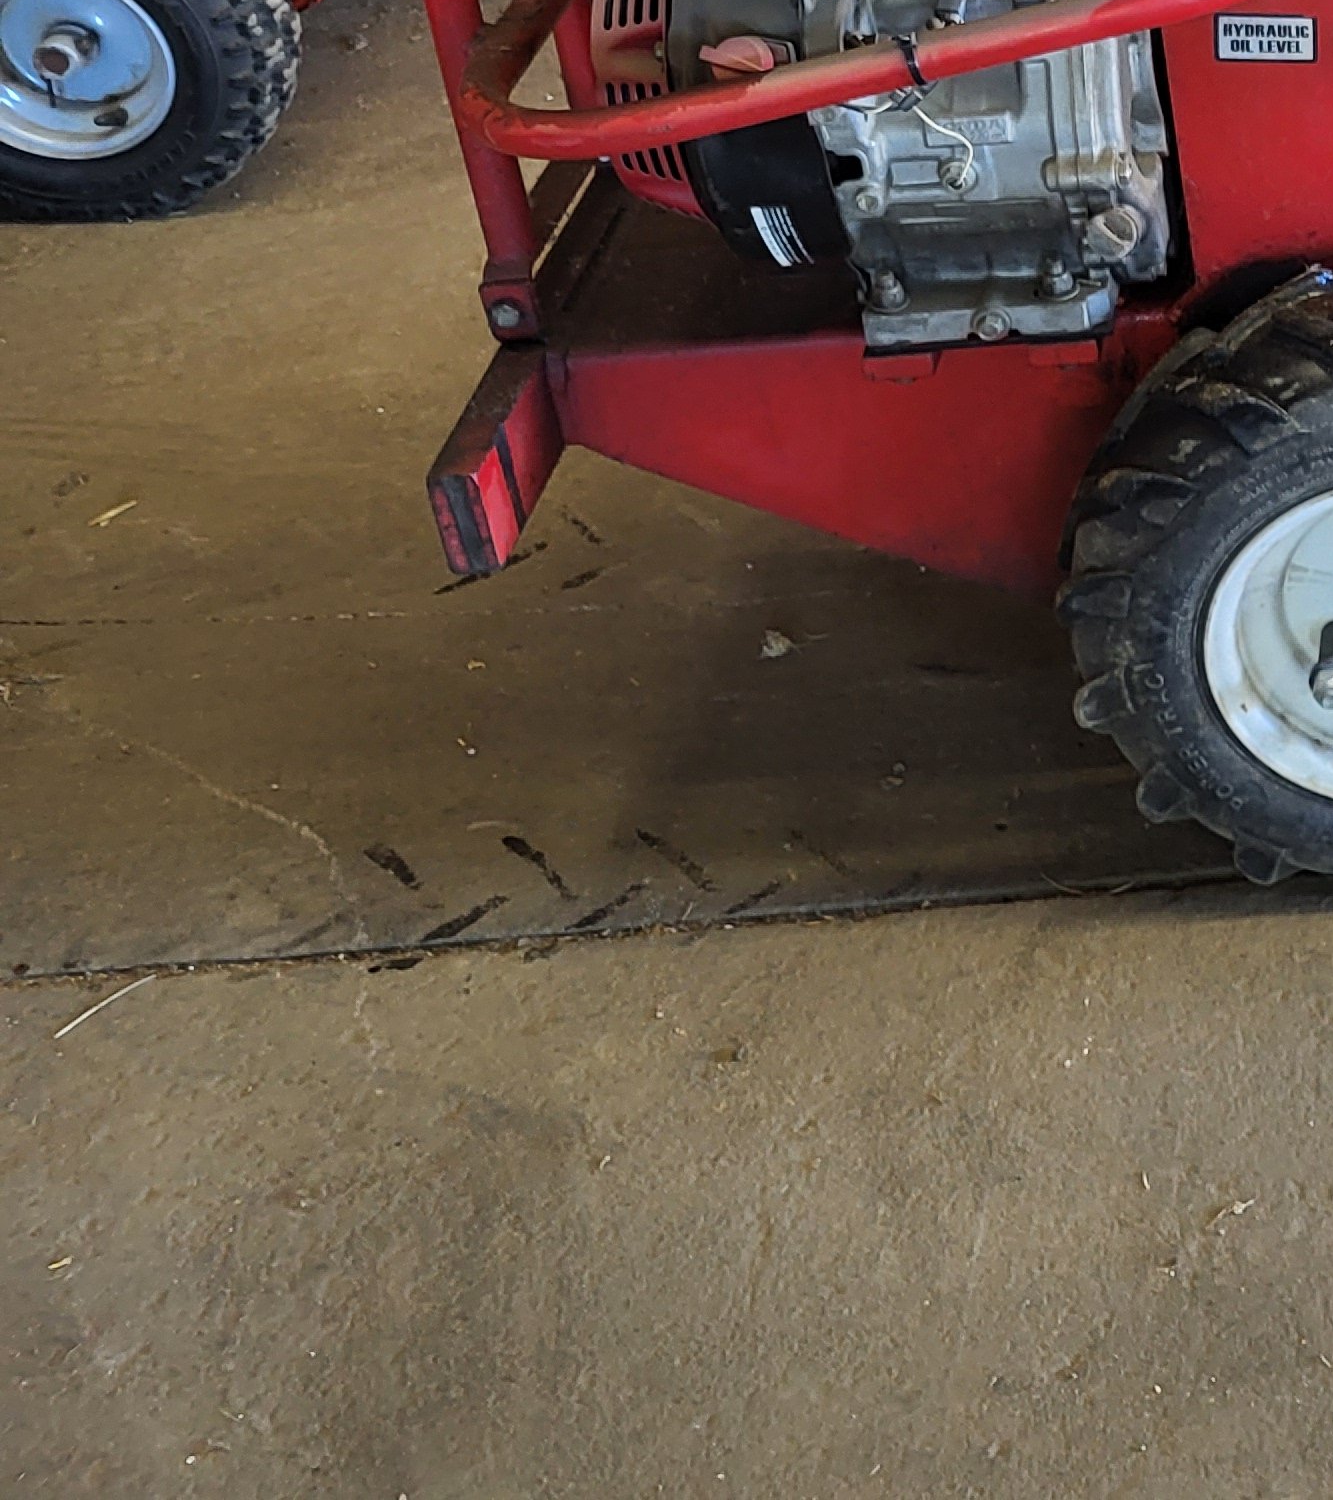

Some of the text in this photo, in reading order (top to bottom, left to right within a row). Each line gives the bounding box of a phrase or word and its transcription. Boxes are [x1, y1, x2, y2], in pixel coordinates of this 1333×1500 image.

[1223, 23, 1310, 39] HYDRAULIC
[1230, 39, 1304, 54] OIL LEVEL
